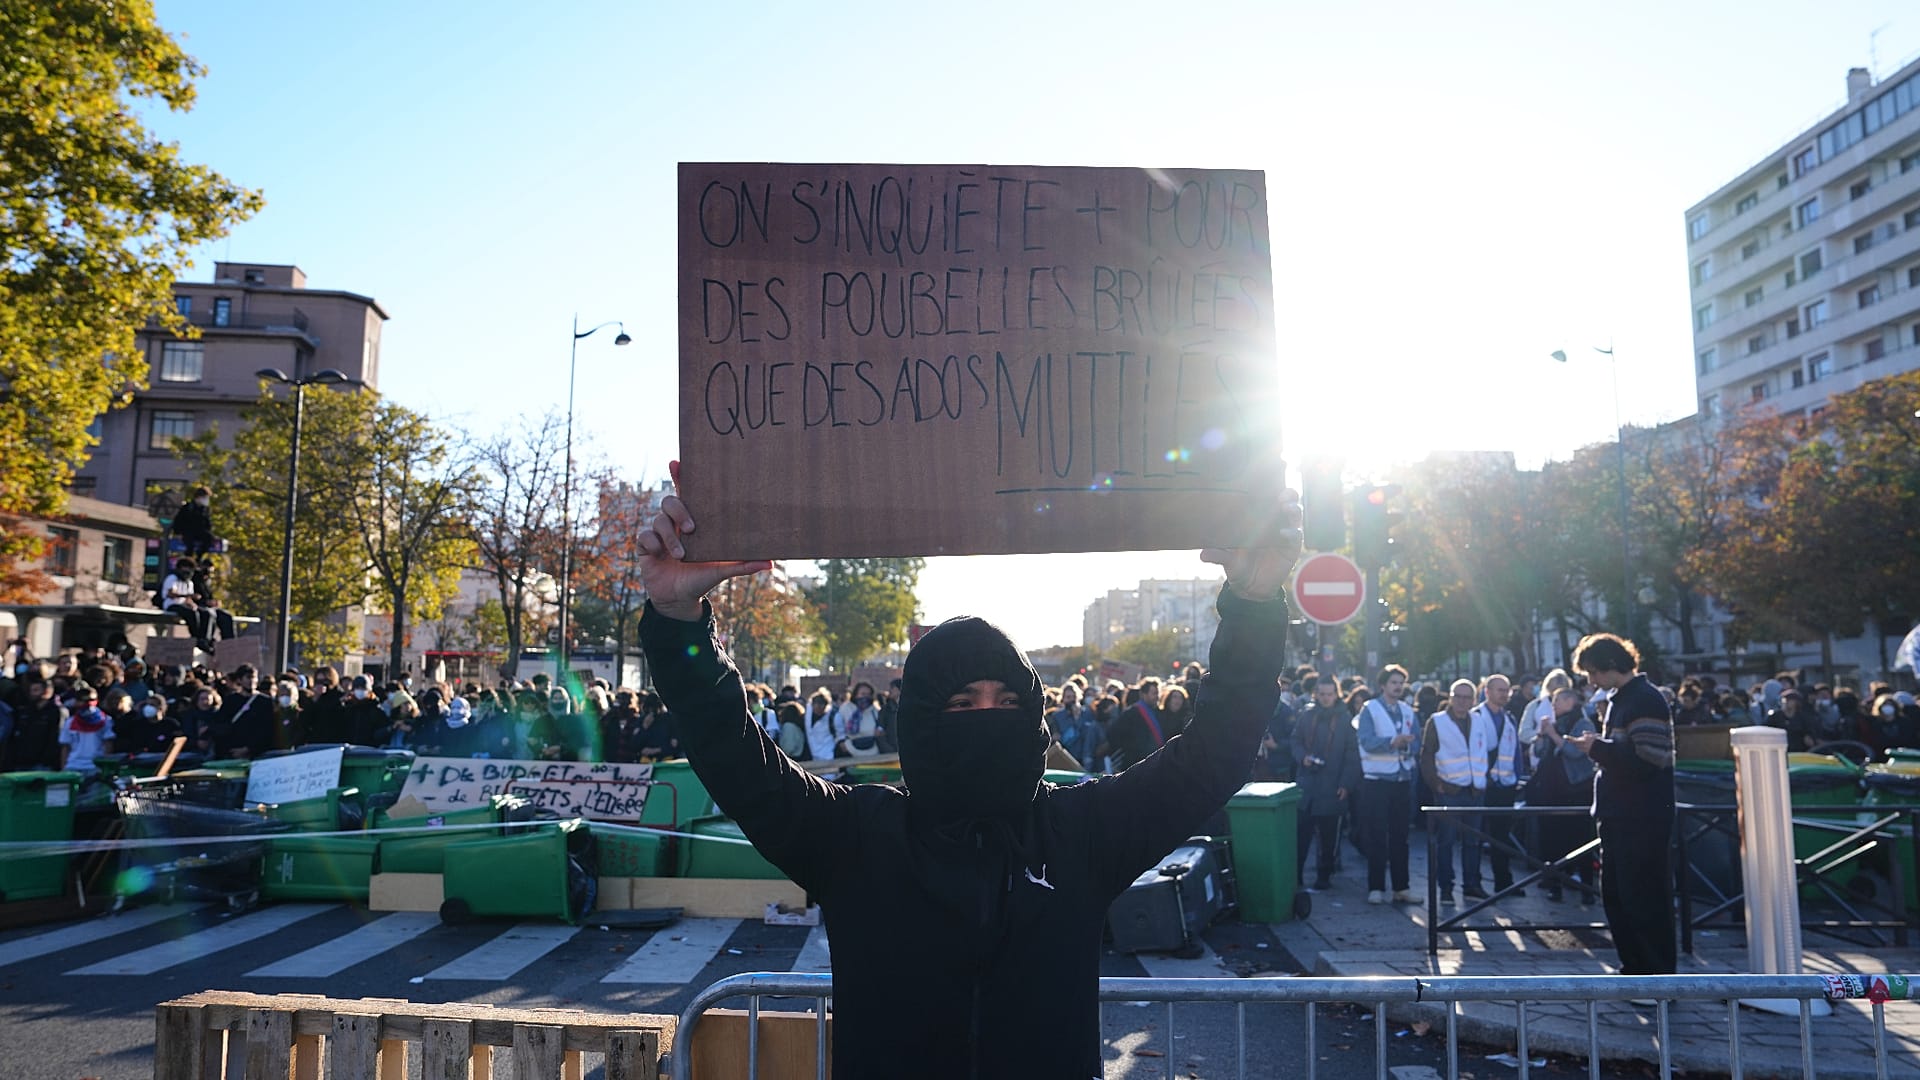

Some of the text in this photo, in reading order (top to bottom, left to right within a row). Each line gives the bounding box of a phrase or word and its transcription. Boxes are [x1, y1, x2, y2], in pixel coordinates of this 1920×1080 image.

[701, 180, 769, 248] ON
[793, 172, 1061, 267] S'INQUIÈTE
[1147, 181, 1259, 250] POUR
[702, 256, 1260, 344] DES POUBELLES BRÛLÉES
[705, 340, 1251, 483] QUE DES ADOS MUTILÉS
[447, 788, 468, 803] de
